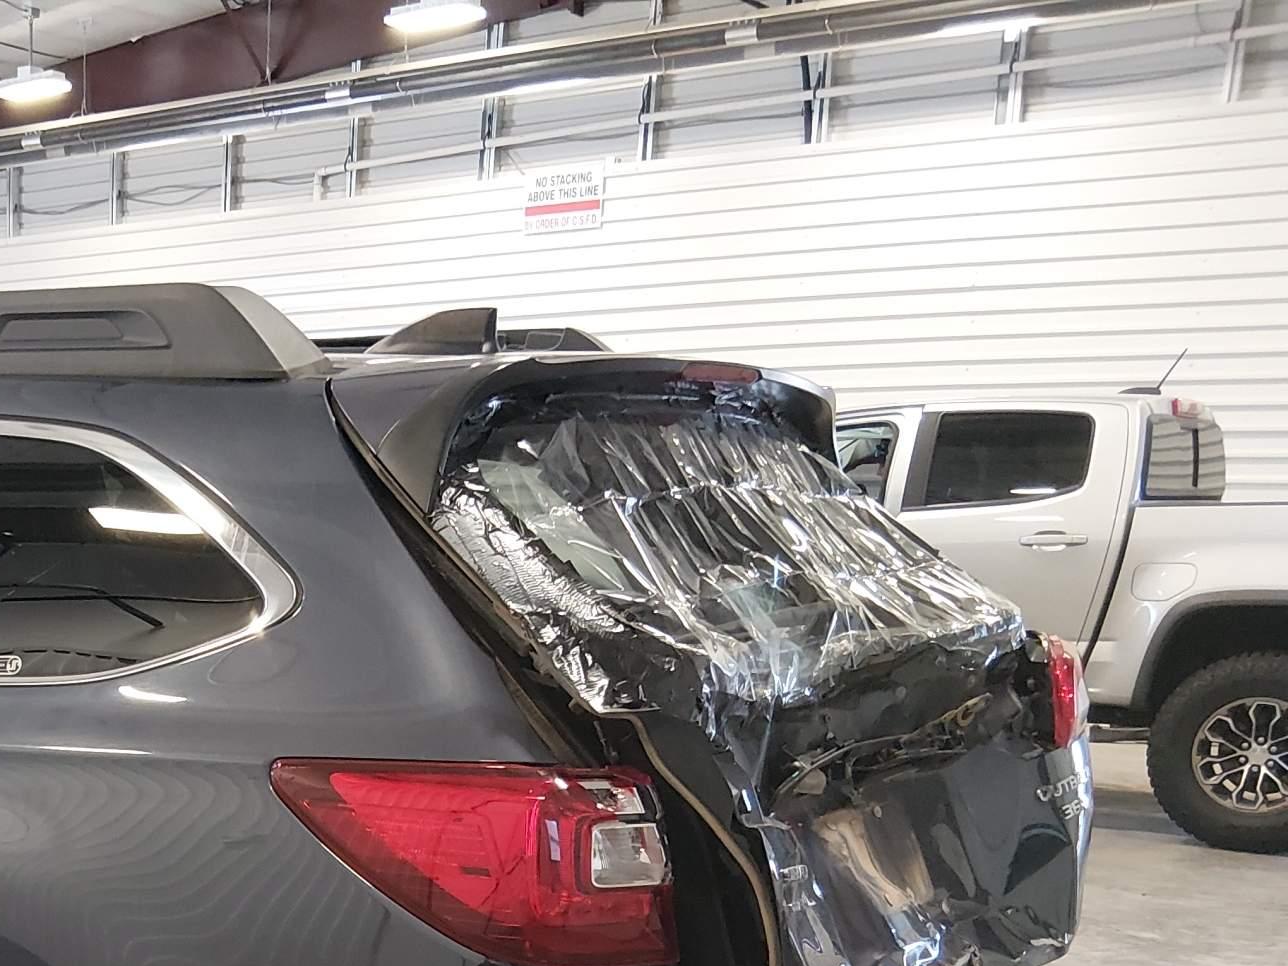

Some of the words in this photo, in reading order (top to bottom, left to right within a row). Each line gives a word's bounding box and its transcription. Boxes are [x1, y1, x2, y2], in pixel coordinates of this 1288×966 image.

[535, 176, 548, 188] NO
[550, 171, 593, 186] STACKING
[527, 189, 556, 203] ABOVE
[559, 187, 577, 200] THIS
[579, 185, 599, 198] LINE
